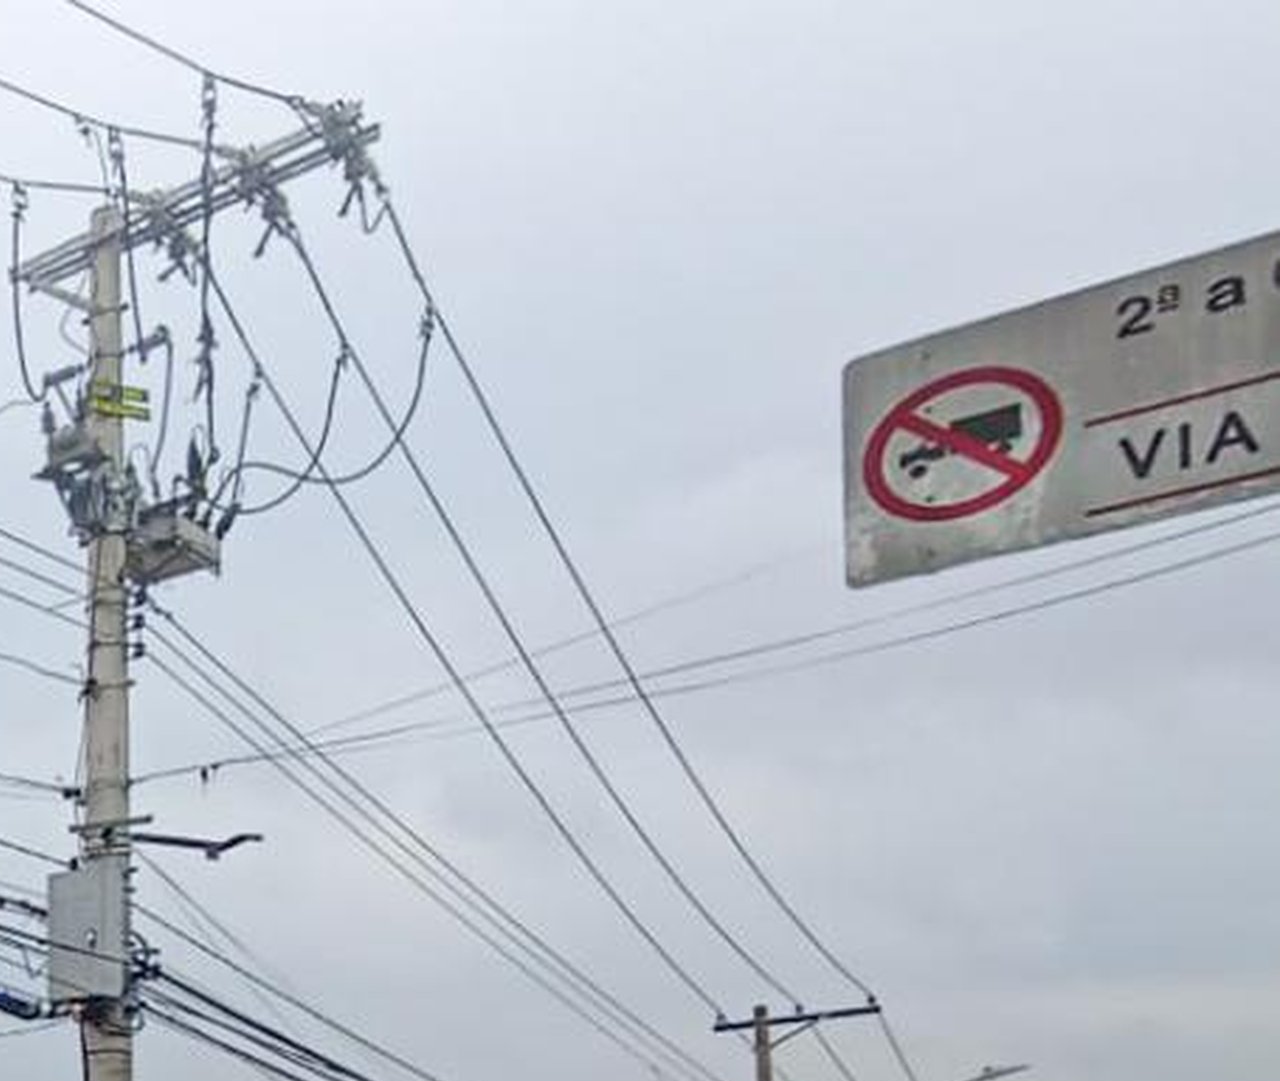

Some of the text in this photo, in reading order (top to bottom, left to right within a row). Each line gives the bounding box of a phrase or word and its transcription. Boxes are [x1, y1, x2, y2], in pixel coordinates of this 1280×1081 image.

[1116, 275, 1247, 339] 2ª a
[1119, 410, 1260, 480] VIA
